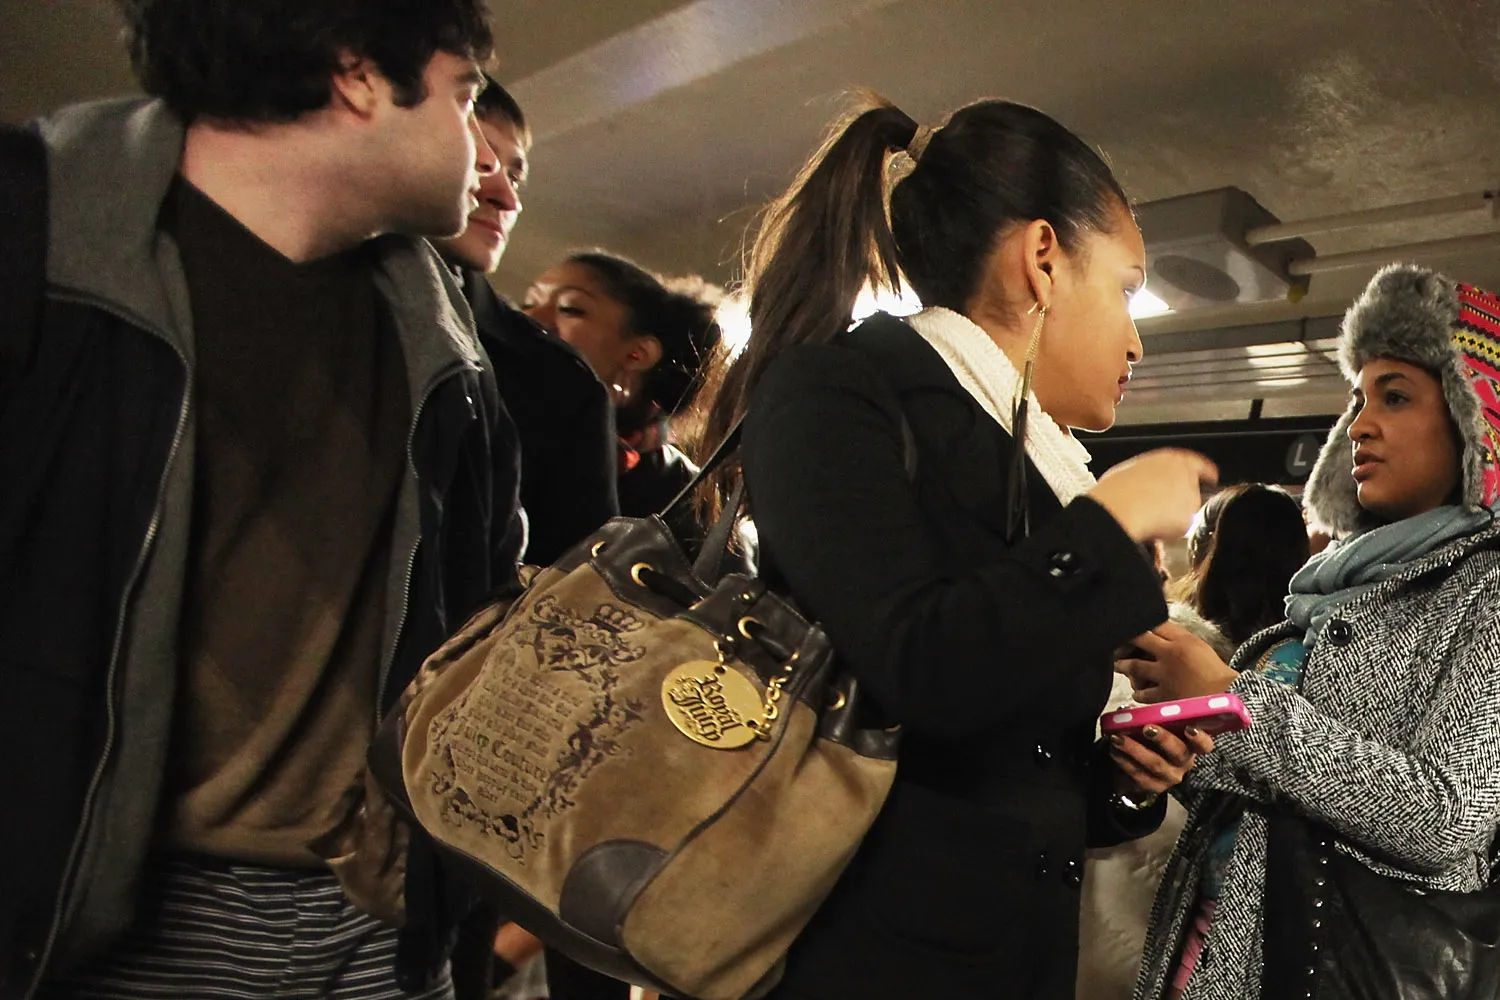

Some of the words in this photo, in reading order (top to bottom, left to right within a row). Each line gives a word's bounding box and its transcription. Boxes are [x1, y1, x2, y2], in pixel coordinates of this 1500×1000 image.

[1293, 443, 1307, 467] L
[668, 687, 723, 741] Juicy
[690, 673, 744, 735] Royal
